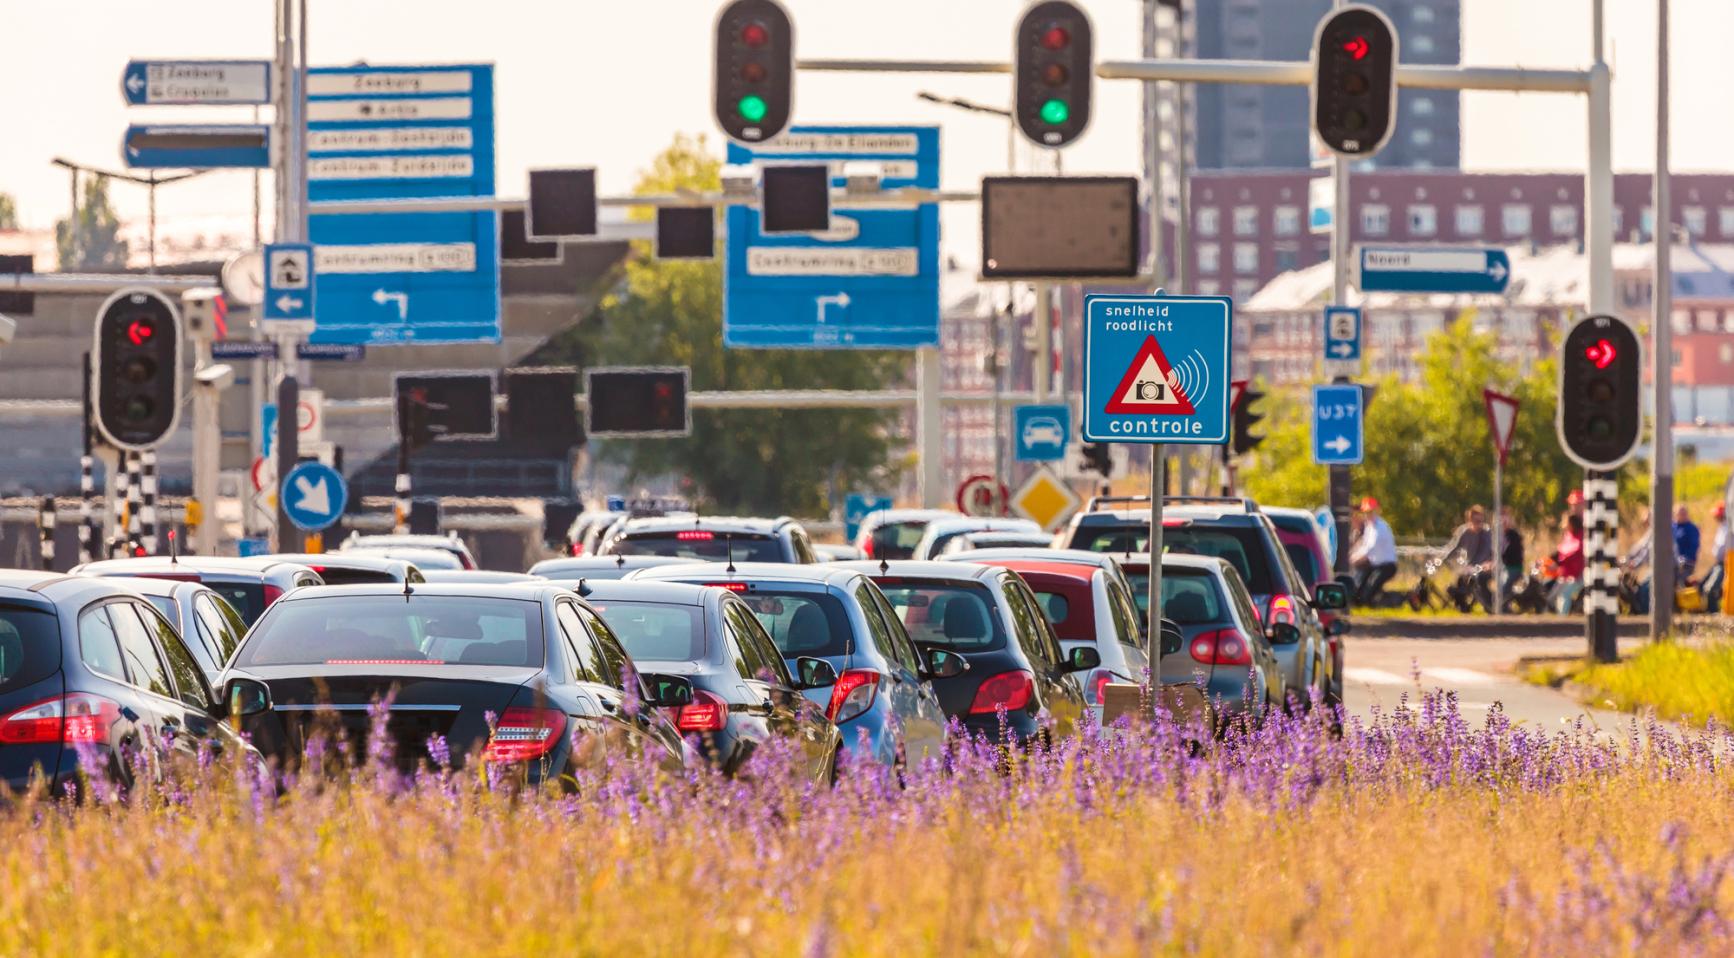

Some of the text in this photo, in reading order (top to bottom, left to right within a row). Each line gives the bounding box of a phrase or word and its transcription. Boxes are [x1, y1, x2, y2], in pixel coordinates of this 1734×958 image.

[168, 66, 225, 80] Zeeburg
[353, 75, 421, 90] Zeeburg
[1368, 254, 1411, 265] Noord
[1105, 305, 1169, 317] snelheid
[1105, 320, 1173, 332] roodlicht
[1318, 404, 1357, 420] U37
[1109, 418, 1203, 434] controle
